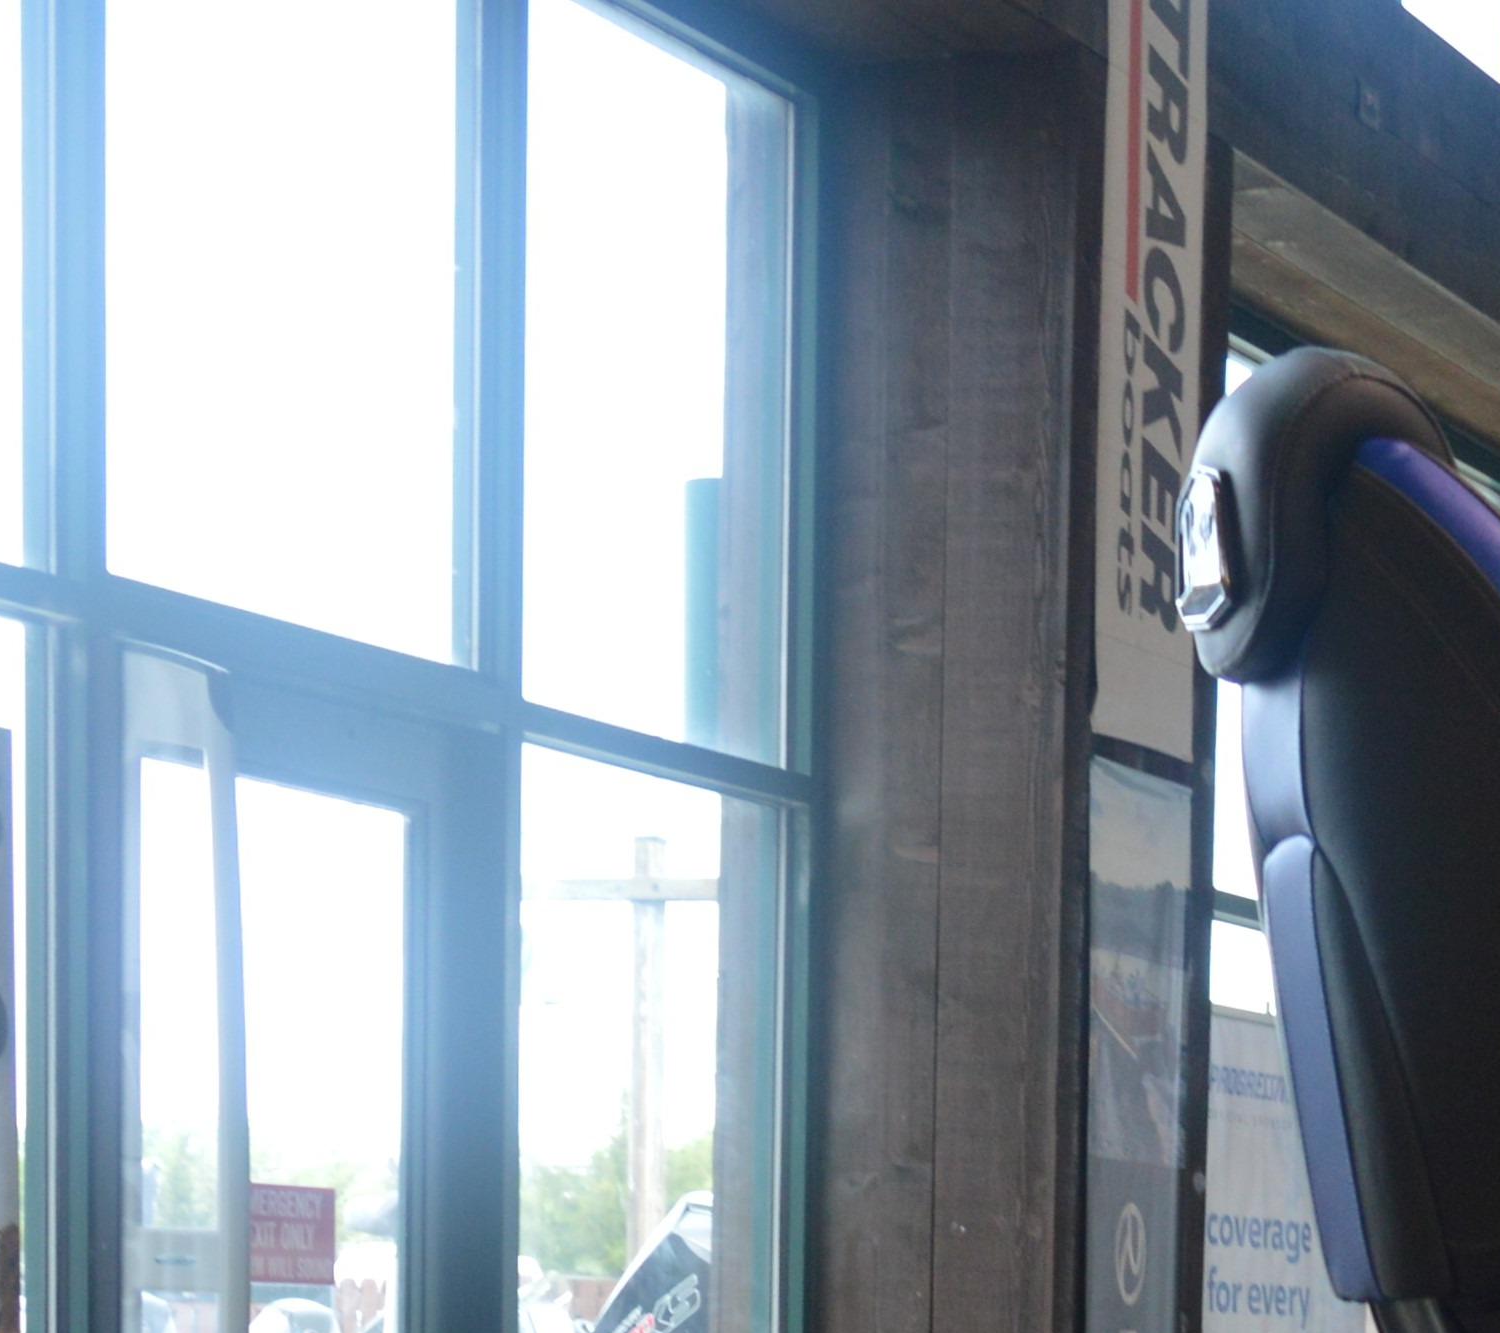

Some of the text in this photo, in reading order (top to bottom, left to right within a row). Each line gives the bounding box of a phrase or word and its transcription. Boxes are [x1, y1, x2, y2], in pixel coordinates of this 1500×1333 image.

[1116, 307, 1141, 615] boats
[1207, 1212, 1312, 1264] coverage
[1207, 1265, 1311, 1331] for every
